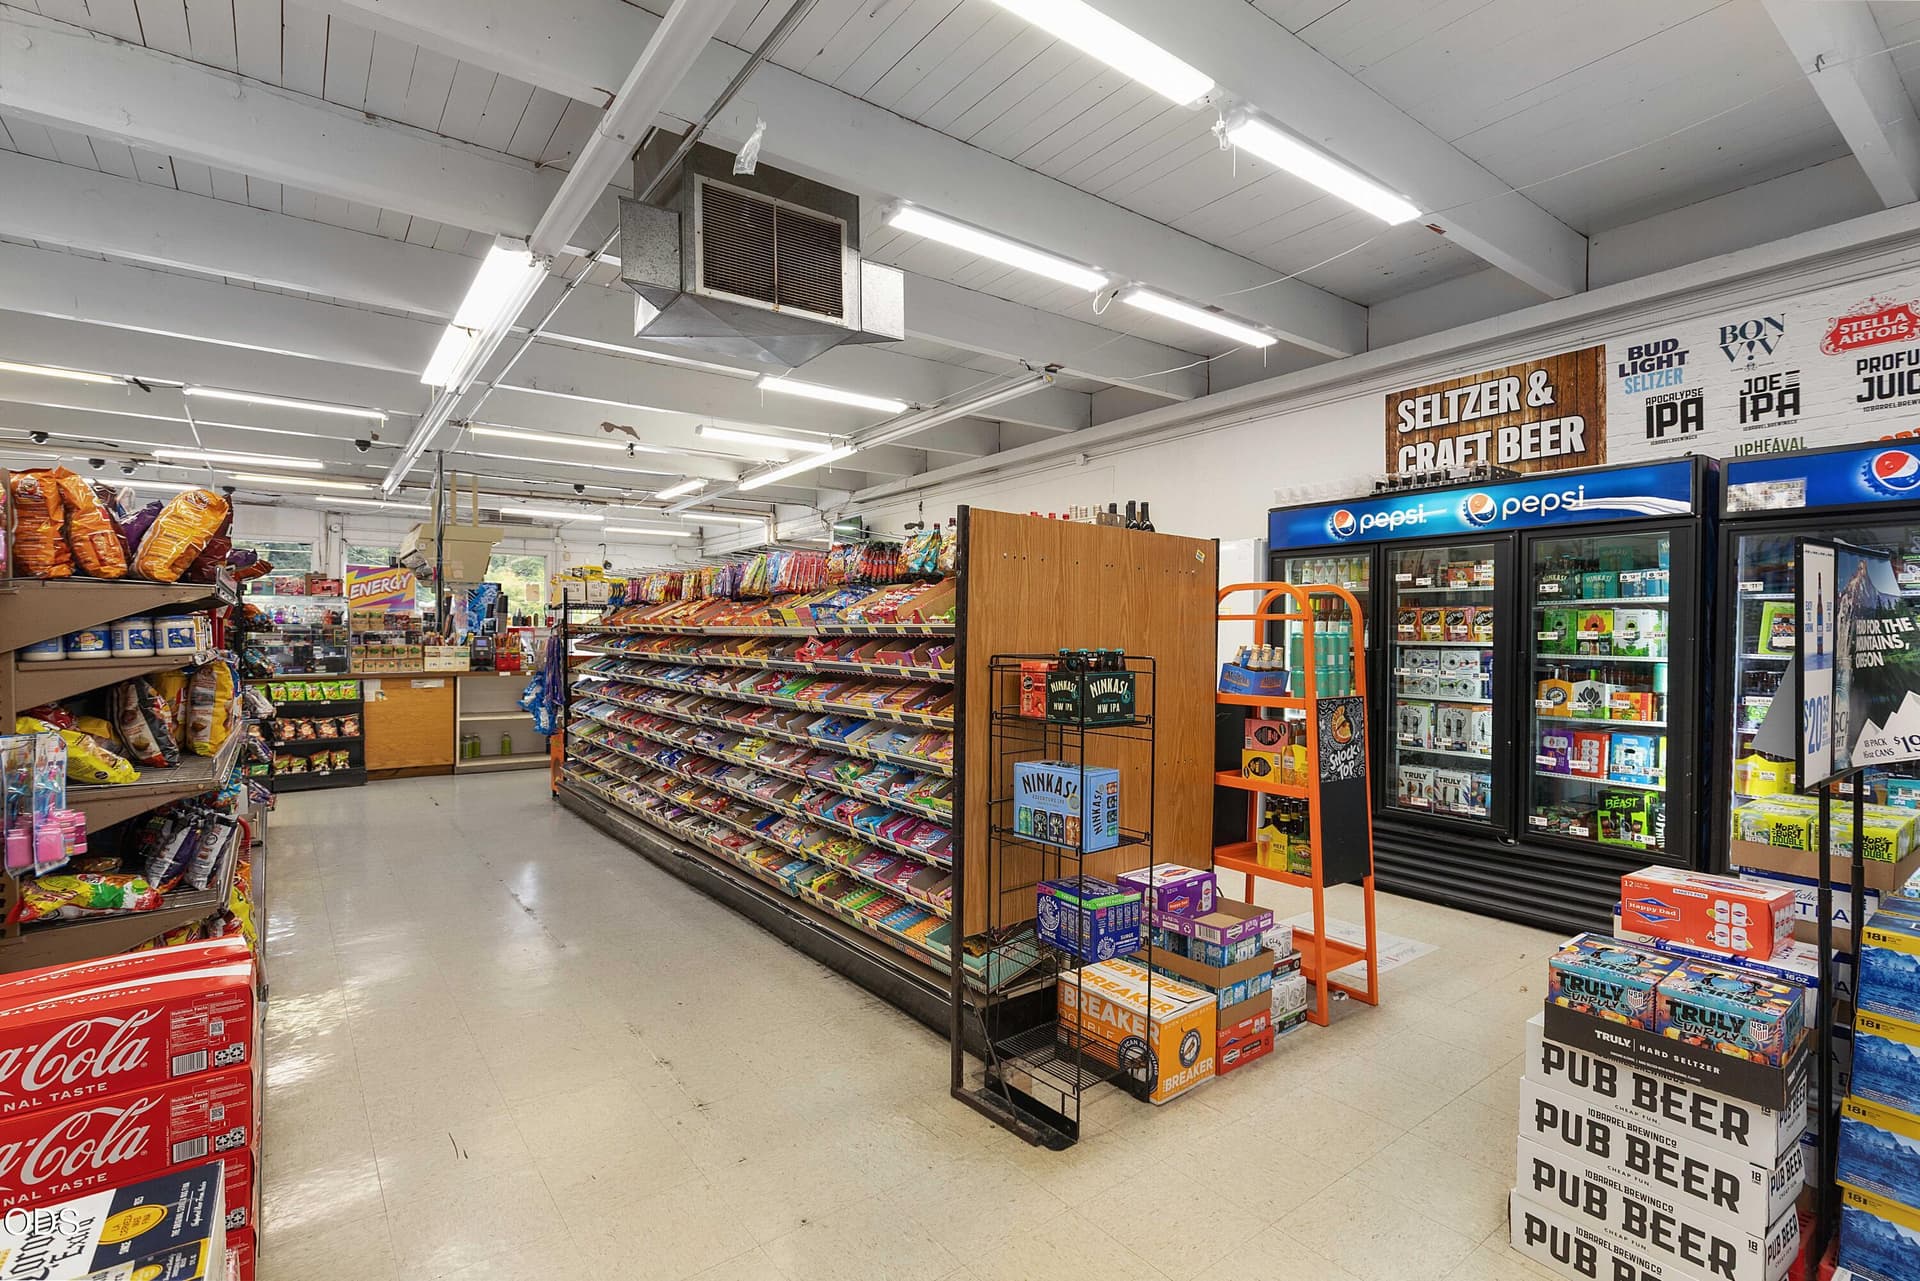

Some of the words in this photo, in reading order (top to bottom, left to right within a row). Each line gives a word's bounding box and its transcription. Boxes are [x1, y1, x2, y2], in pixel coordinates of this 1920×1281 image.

[1718, 312, 1786, 346] BON
[1839, 312, 1908, 335] STELLA
[1839, 322, 1911, 346] ARTOIS
[1628, 338, 1679, 362] BUD
[1618, 350, 1690, 379] LIGHT
[1624, 367, 1684, 395] SELTZER
[1740, 372, 1782, 396] JOE
[1397, 375, 1521, 433] SELTZER
[1527, 369, 1555, 408] &
[1645, 387, 1704, 405] APOCALYPSE
[1739, 387, 1800, 424] IPA
[1646, 396, 1704, 439] IPA
[1398, 430, 1492, 474] CRAFT
[1498, 415, 1586, 464] BEER
[1501, 484, 1586, 521] pepsi
[1360, 504, 1425, 530] pepsi
[350, 573, 412, 599] ENERGY
[1867, 619, 1882, 634] FOR
[1881, 617, 1915, 633] THE
[1050, 680, 1077, 693] NINKASI
[1089, 679, 1128, 699] NINKASI
[1053, 703, 1064, 712] NW
[1065, 703, 1073, 712] IPA
[1097, 703, 1109, 714] NW
[1110, 702, 1121, 713] IPA
[1870, 738, 1887, 747] PACK
[1875, 748, 1895, 758] CANS
[1337, 760, 1355, 780] TOP
[1404, 771, 1427, 780] TRULY
[1439, 777, 1461, 785] TRULY
[1022, 772, 1078, 799] NINKASI
[1091, 788, 1104, 835] NINKASI
[1605, 797, 1639, 809] BEAST
[1775, 823, 1794, 832] HOP
[1772, 837, 1804, 847] DOUBLE
[1623, 880, 1634, 888] 12
[1629, 902, 1657, 915] Happy
[1659, 907, 1677, 917] Dad
[1866, 932, 1880, 940] 18
[1082, 971, 1175, 1013] BREAKER
[1556, 972, 1624, 1001] TRULY
[1627, 989, 1643, 999] USA
[1572, 992, 1619, 1010] UNRULY
[1064, 986, 1160, 1046] BREAKER
[1666, 999, 1745, 1034] TRULY
[1751, 1021, 1768, 1032] USA
[1860, 1018, 1874, 1028] 18
[1683, 1023, 1741, 1043] UNRULY
[1594, 1030, 1631, 1048] TRULY
[1639, 1044, 1669, 1060] HARD
[1674, 1055, 1721, 1075] SELTZER
[1165, 1057, 1213, 1092] BREAKER
[3, 1097, 42, 1113] NAL
[49, 1082, 108, 1102] TASTE
[1541, 1041, 1618, 1101] PUB
[1632, 1072, 1749, 1147] BEER
[1615, 1104, 1638, 1117] CHEAP
[1847, 1104, 1860, 1115] 18
[1535, 1098, 1610, 1159] PUB
[1625, 1133, 1740, 1214] BEER
[1607, 1165, 1631, 1178] CHEAP
[1752, 1170, 1761, 1182] 18
[1771, 1168, 1785, 1196] PUB
[1785, 1149, 1803, 1182] BEER
[3, 1191, 41, 1207] NAL
[50, 1173, 107, 1194] TASTE
[1848, 1192, 1862, 1204] 18
[1533, 1157, 1608, 1221] PUB
[1622, 1196, 1737, 1281] BEER
[1604, 1227, 1628, 1241] CHEAP
[1748, 1240, 1758, 1251] 18
[1767, 1241, 1781, 1266] PUB
[1782, 1214, 1798, 1248] BEER
[1525, 1212, 1597, 1280] PUB
